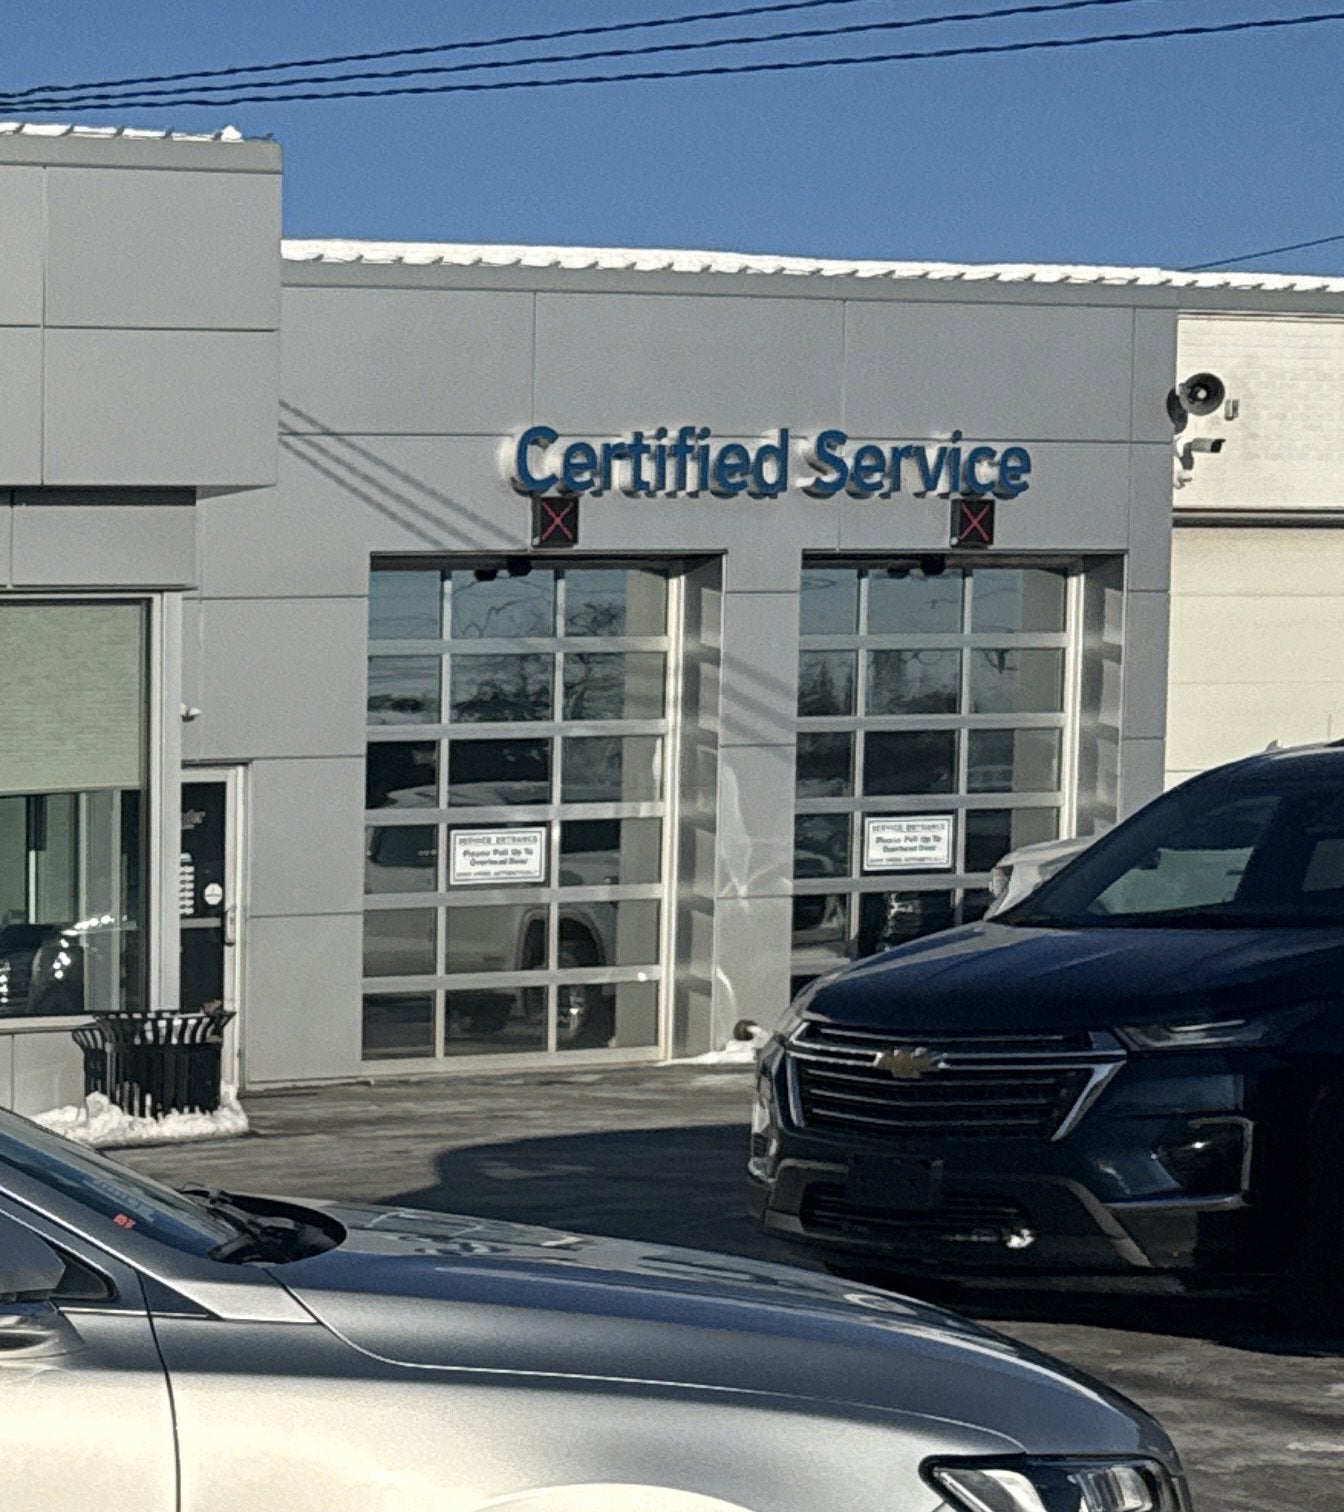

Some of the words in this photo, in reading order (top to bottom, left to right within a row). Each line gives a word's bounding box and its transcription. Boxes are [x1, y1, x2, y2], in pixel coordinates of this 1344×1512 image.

[516, 425, 791, 495] Certified
[813, 428, 1032, 495] Service
[875, 836, 902, 844] Please
[904, 835, 918, 843] Pull
[492, 848, 509, 856] Pull
